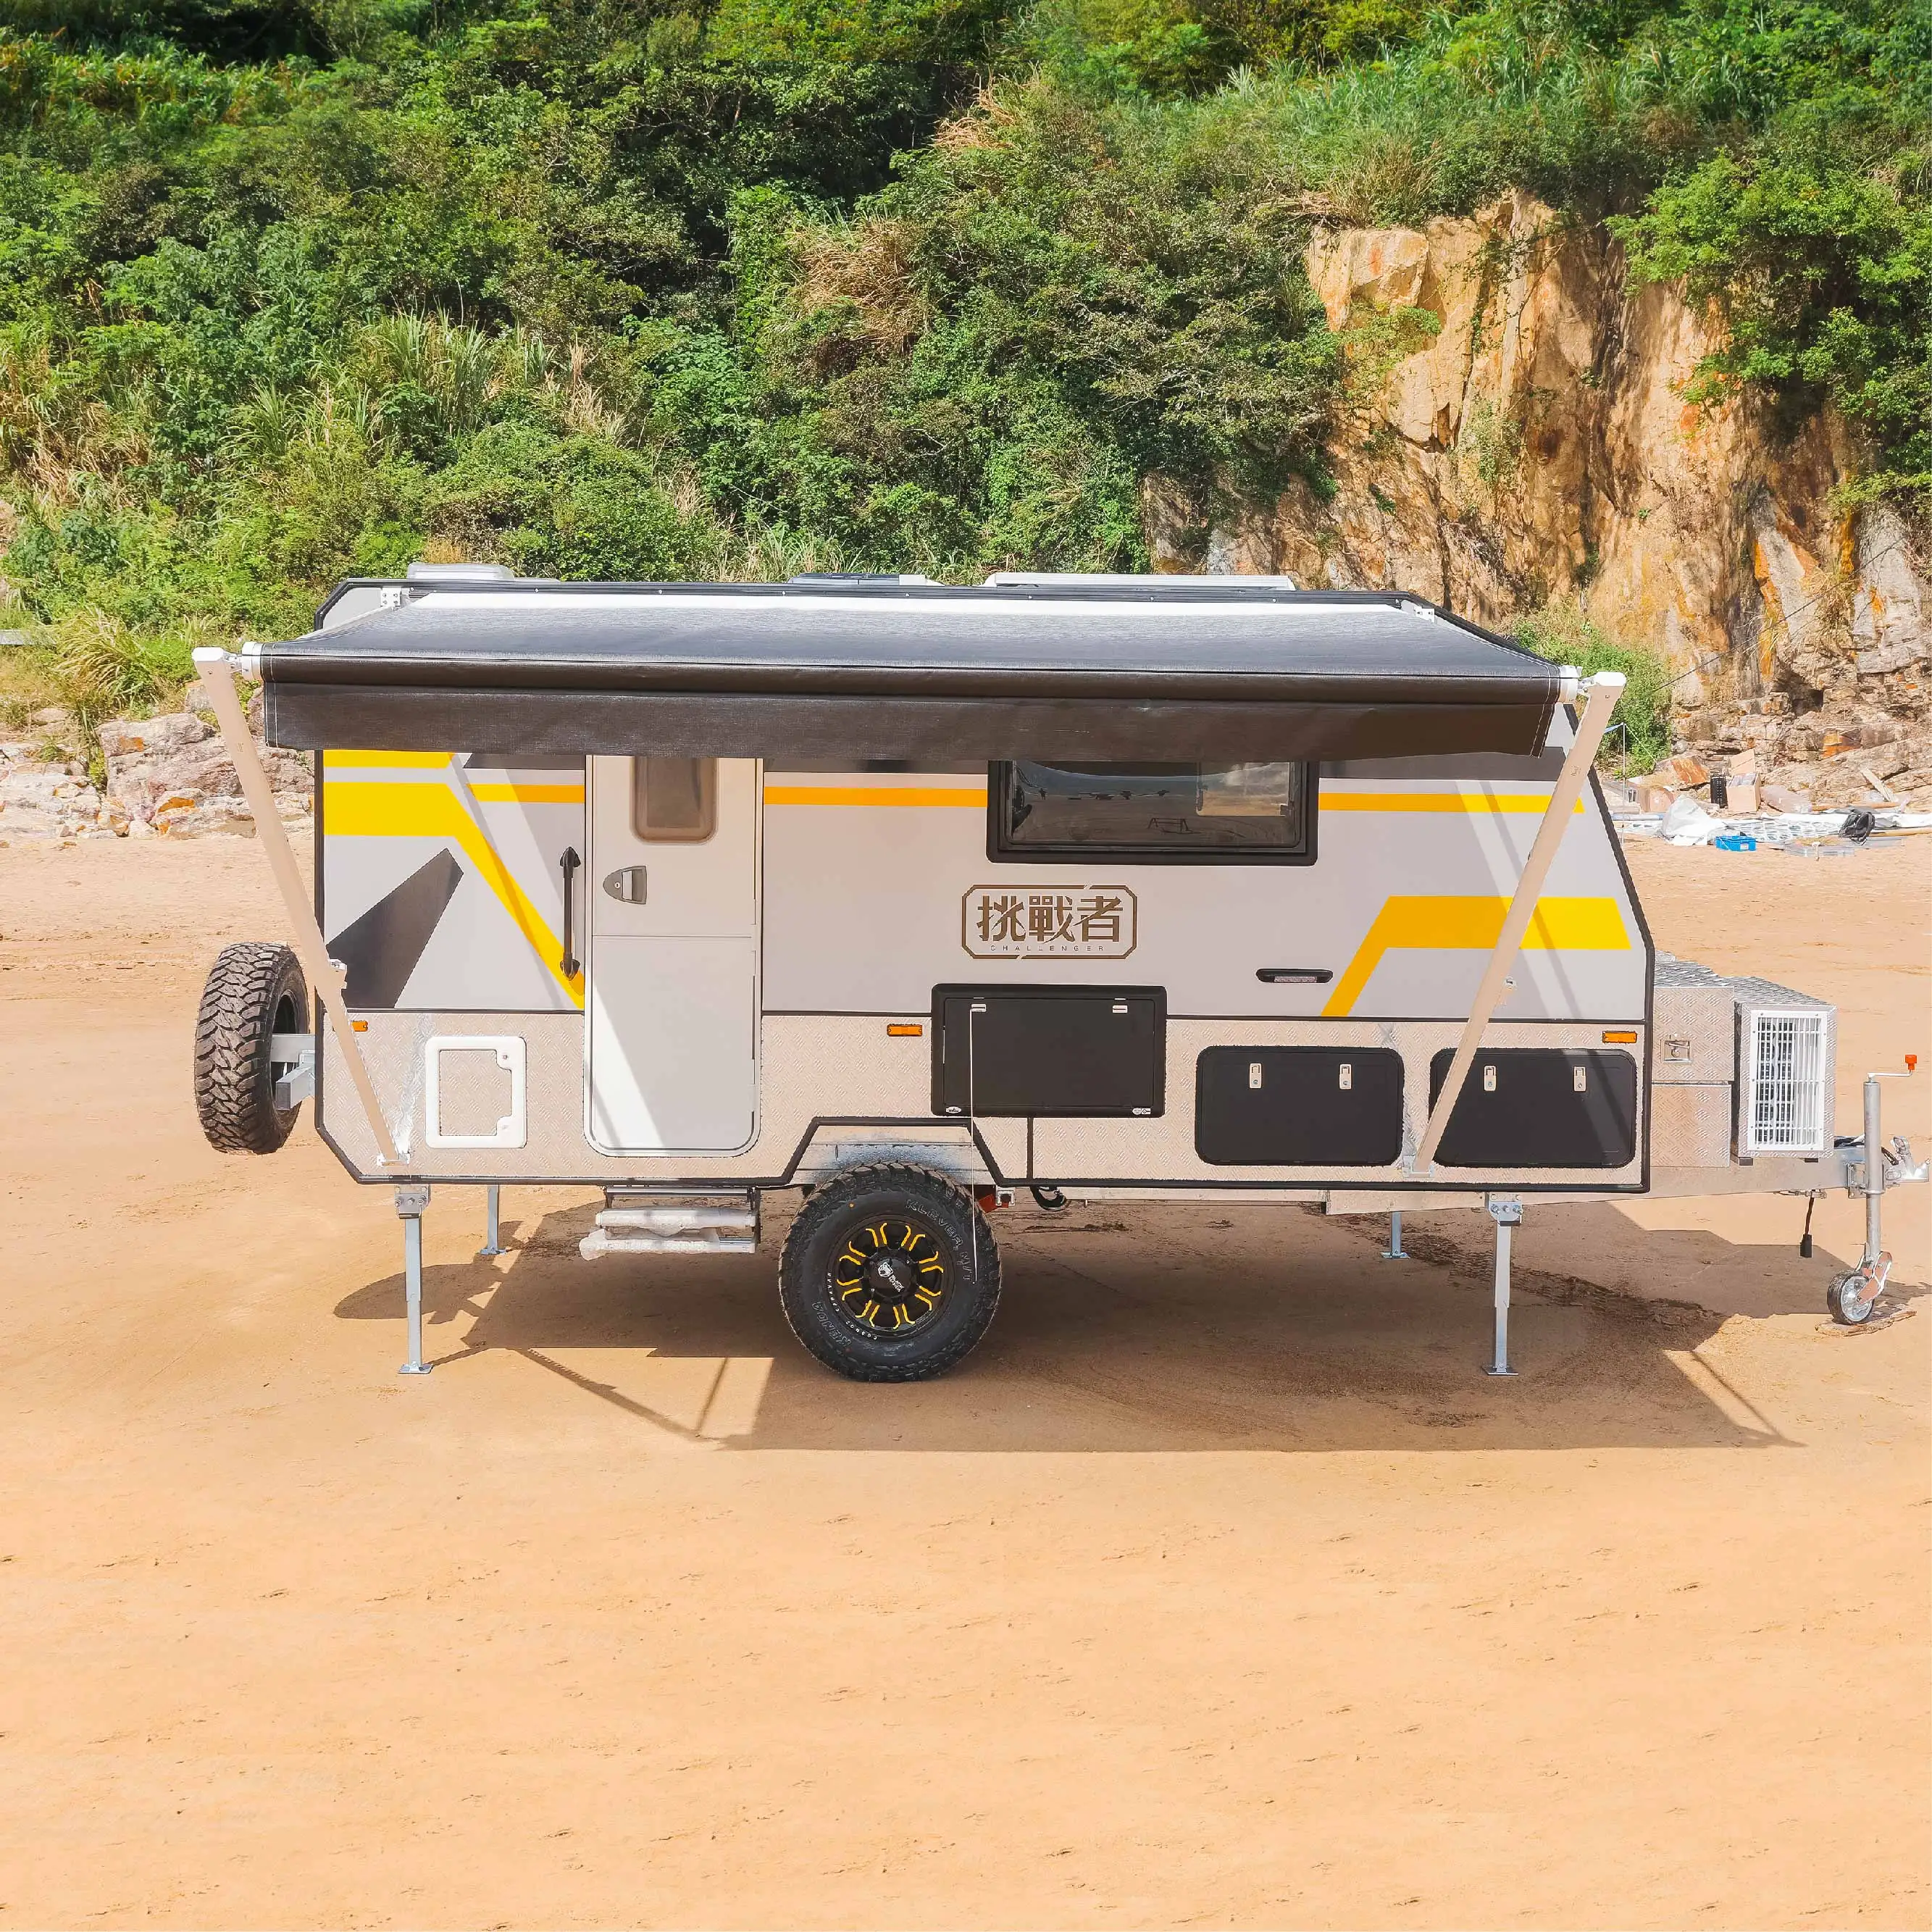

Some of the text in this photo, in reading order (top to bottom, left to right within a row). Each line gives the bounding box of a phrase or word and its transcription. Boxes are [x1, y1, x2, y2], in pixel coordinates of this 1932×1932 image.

[977, 895, 1124, 943] 挑戰者
[906, 1199, 963, 1246] KLEVER
[811, 1301, 852, 1347] KENDA
